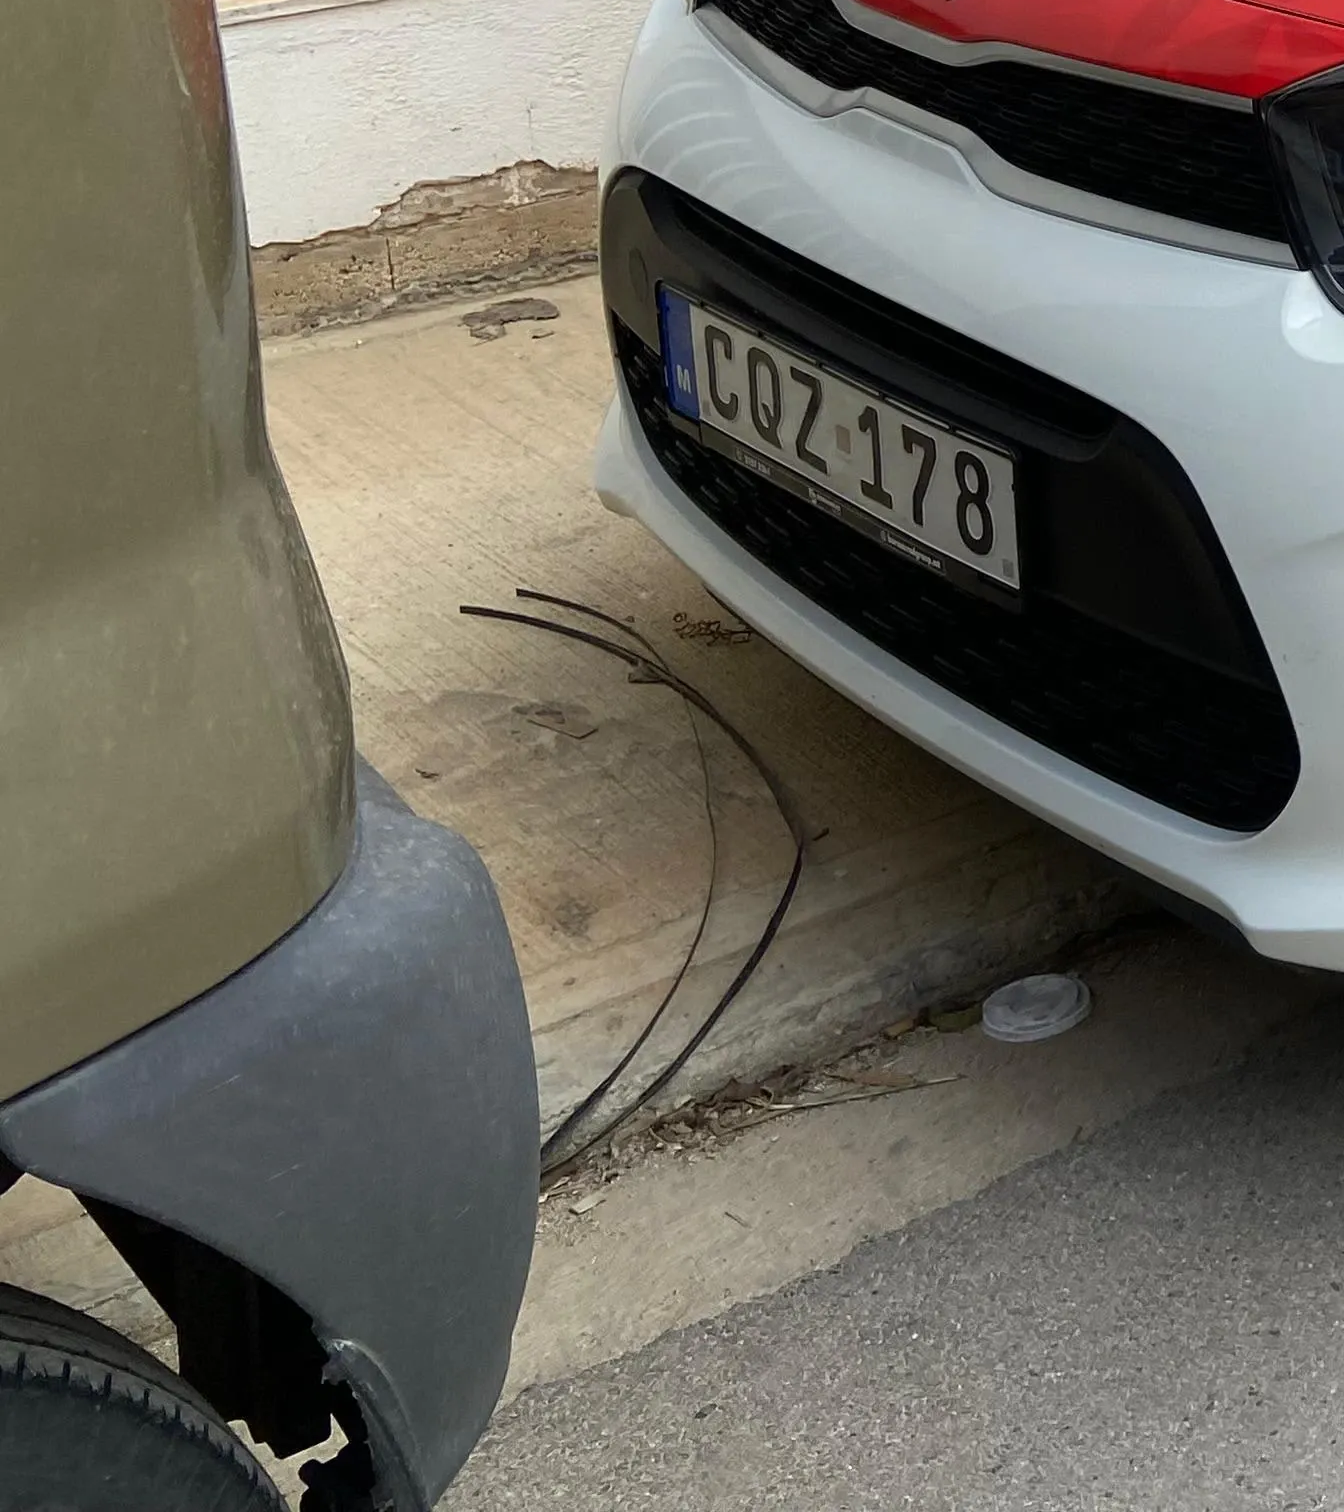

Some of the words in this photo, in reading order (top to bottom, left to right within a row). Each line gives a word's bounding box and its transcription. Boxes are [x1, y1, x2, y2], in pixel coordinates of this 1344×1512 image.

[676, 364, 692, 394] M
[704, 324, 828, 476] CQZ
[857, 405, 995, 556] 178
